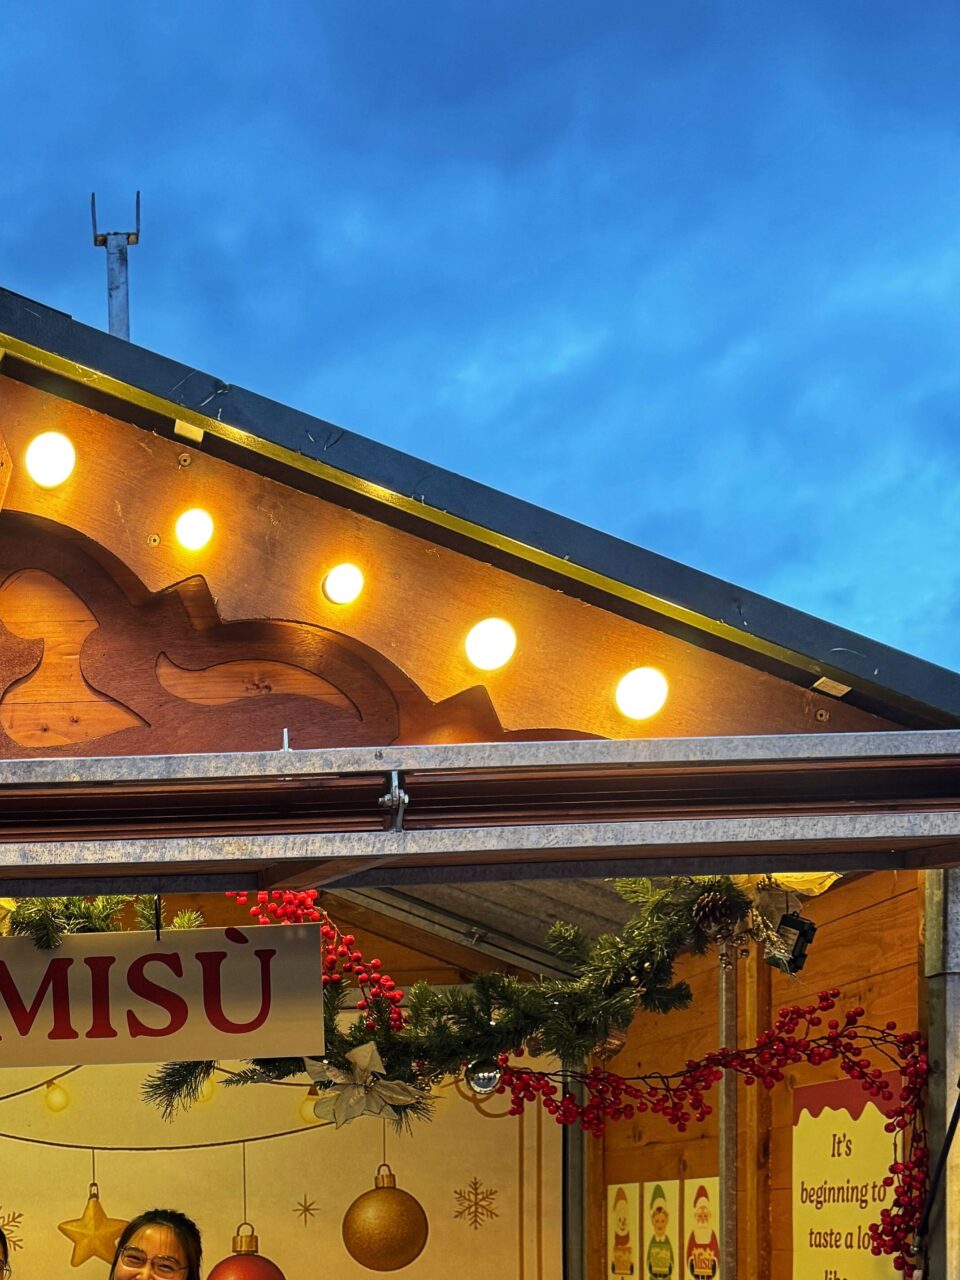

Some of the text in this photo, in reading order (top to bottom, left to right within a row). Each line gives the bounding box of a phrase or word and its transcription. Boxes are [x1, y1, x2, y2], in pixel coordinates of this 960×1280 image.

[801, 1179, 886, 1210] beginning to
[809, 1225, 875, 1250] taste a lo
